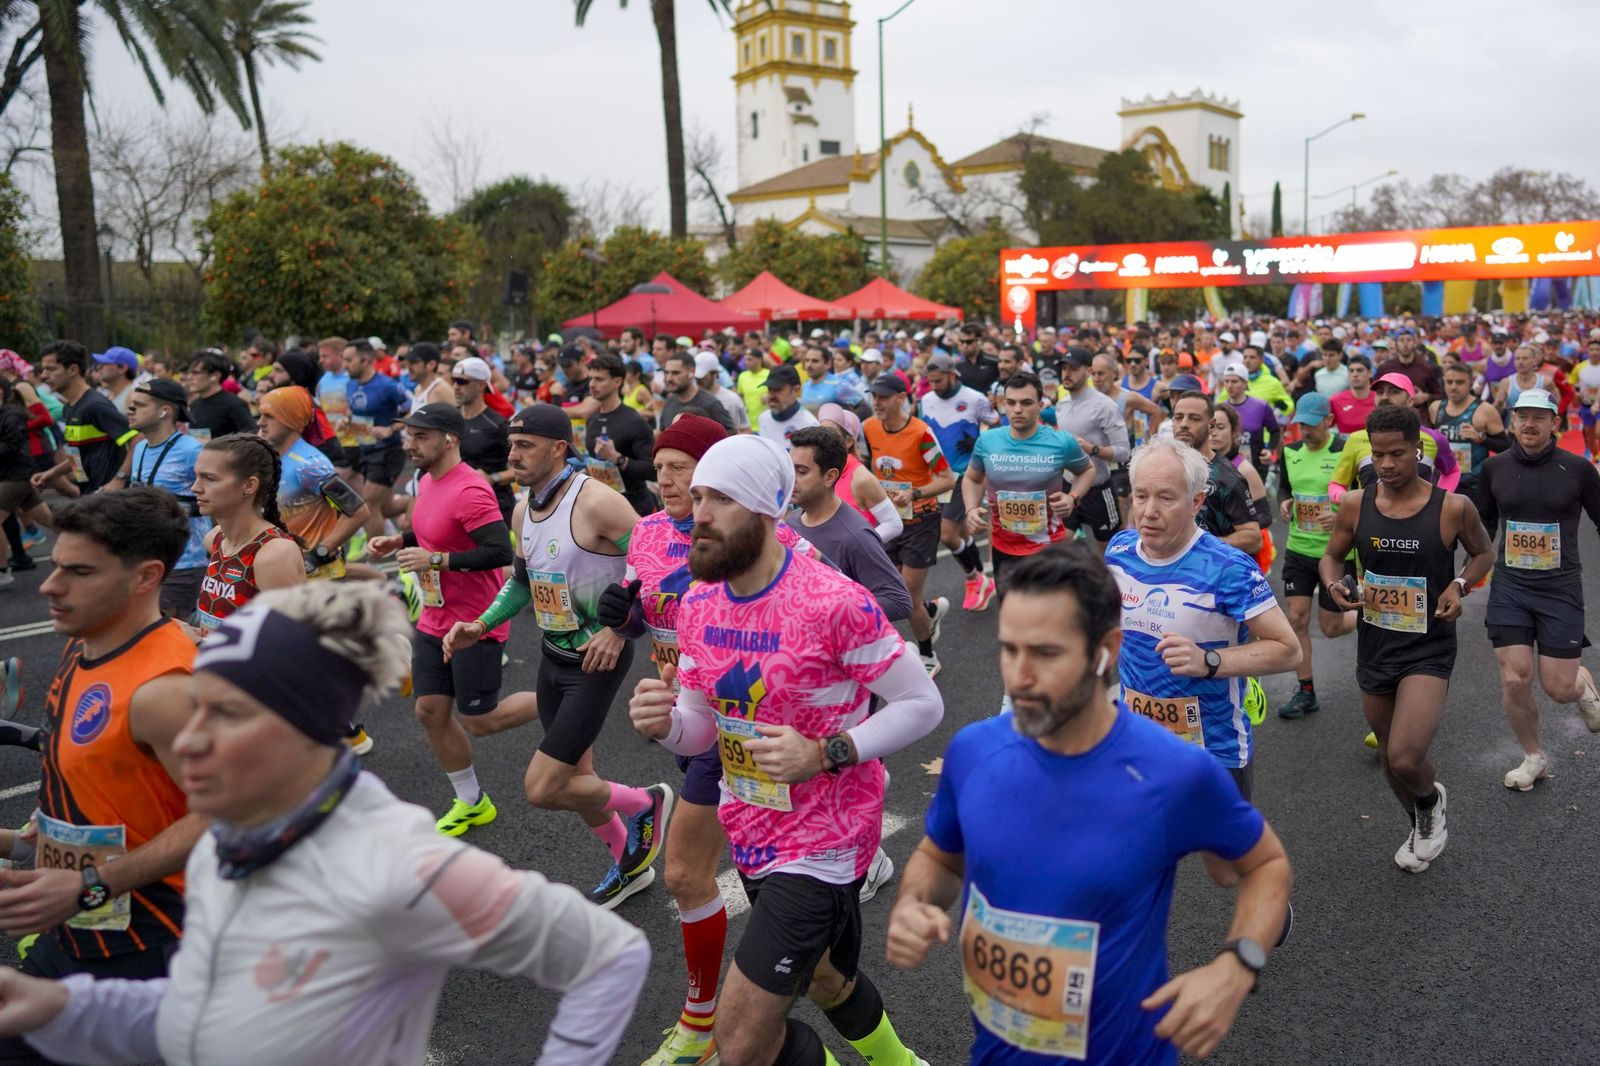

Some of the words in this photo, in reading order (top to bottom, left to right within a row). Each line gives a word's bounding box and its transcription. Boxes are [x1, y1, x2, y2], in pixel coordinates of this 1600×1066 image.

[993, 464, 1023, 472] Sagrado
[1023, 465, 1054, 473] Corazón
[1005, 503, 1035, 516] 5996
[1370, 537, 1420, 550] ROTGER
[1512, 534, 1547, 550] 5684
[201, 575, 236, 600] KENYA
[533, 584, 557, 606] 4531
[1370, 588, 1408, 608] 7231
[1147, 607, 1176, 620] MARATONA
[1150, 622, 1163, 634] 8K
[704, 625, 780, 653] MONTALBÁN
[1132, 697, 1180, 724] 6438
[641, 815, 654, 850] HOKA
[973, 934, 1054, 998] 6868
